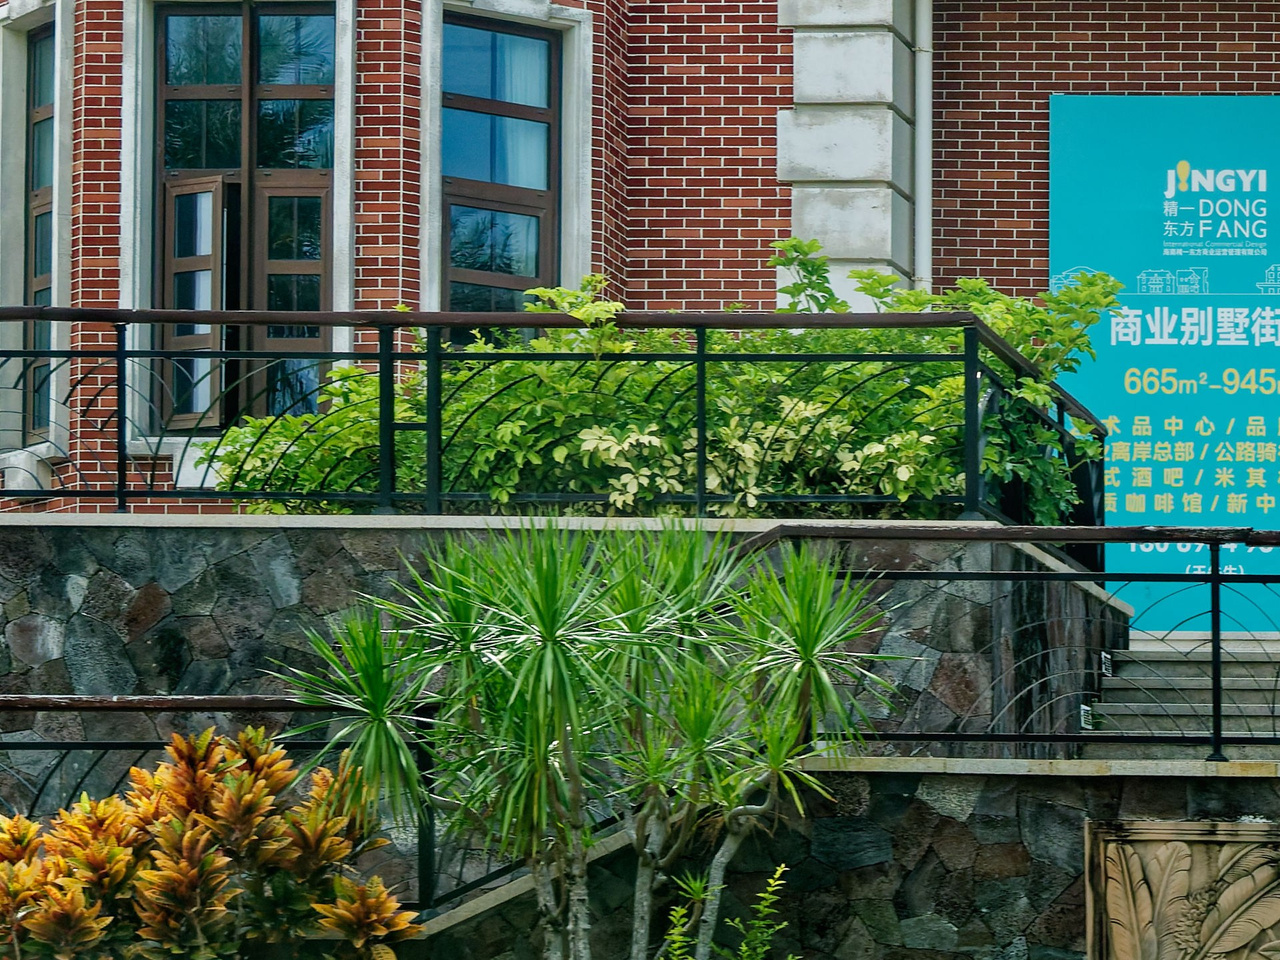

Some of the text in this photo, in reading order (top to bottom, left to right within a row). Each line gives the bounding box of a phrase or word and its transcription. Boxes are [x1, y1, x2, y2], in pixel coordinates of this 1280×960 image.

[1163, 198, 1267, 217] 精一 DONG
[1163, 220, 1267, 238] 东方 FANG
